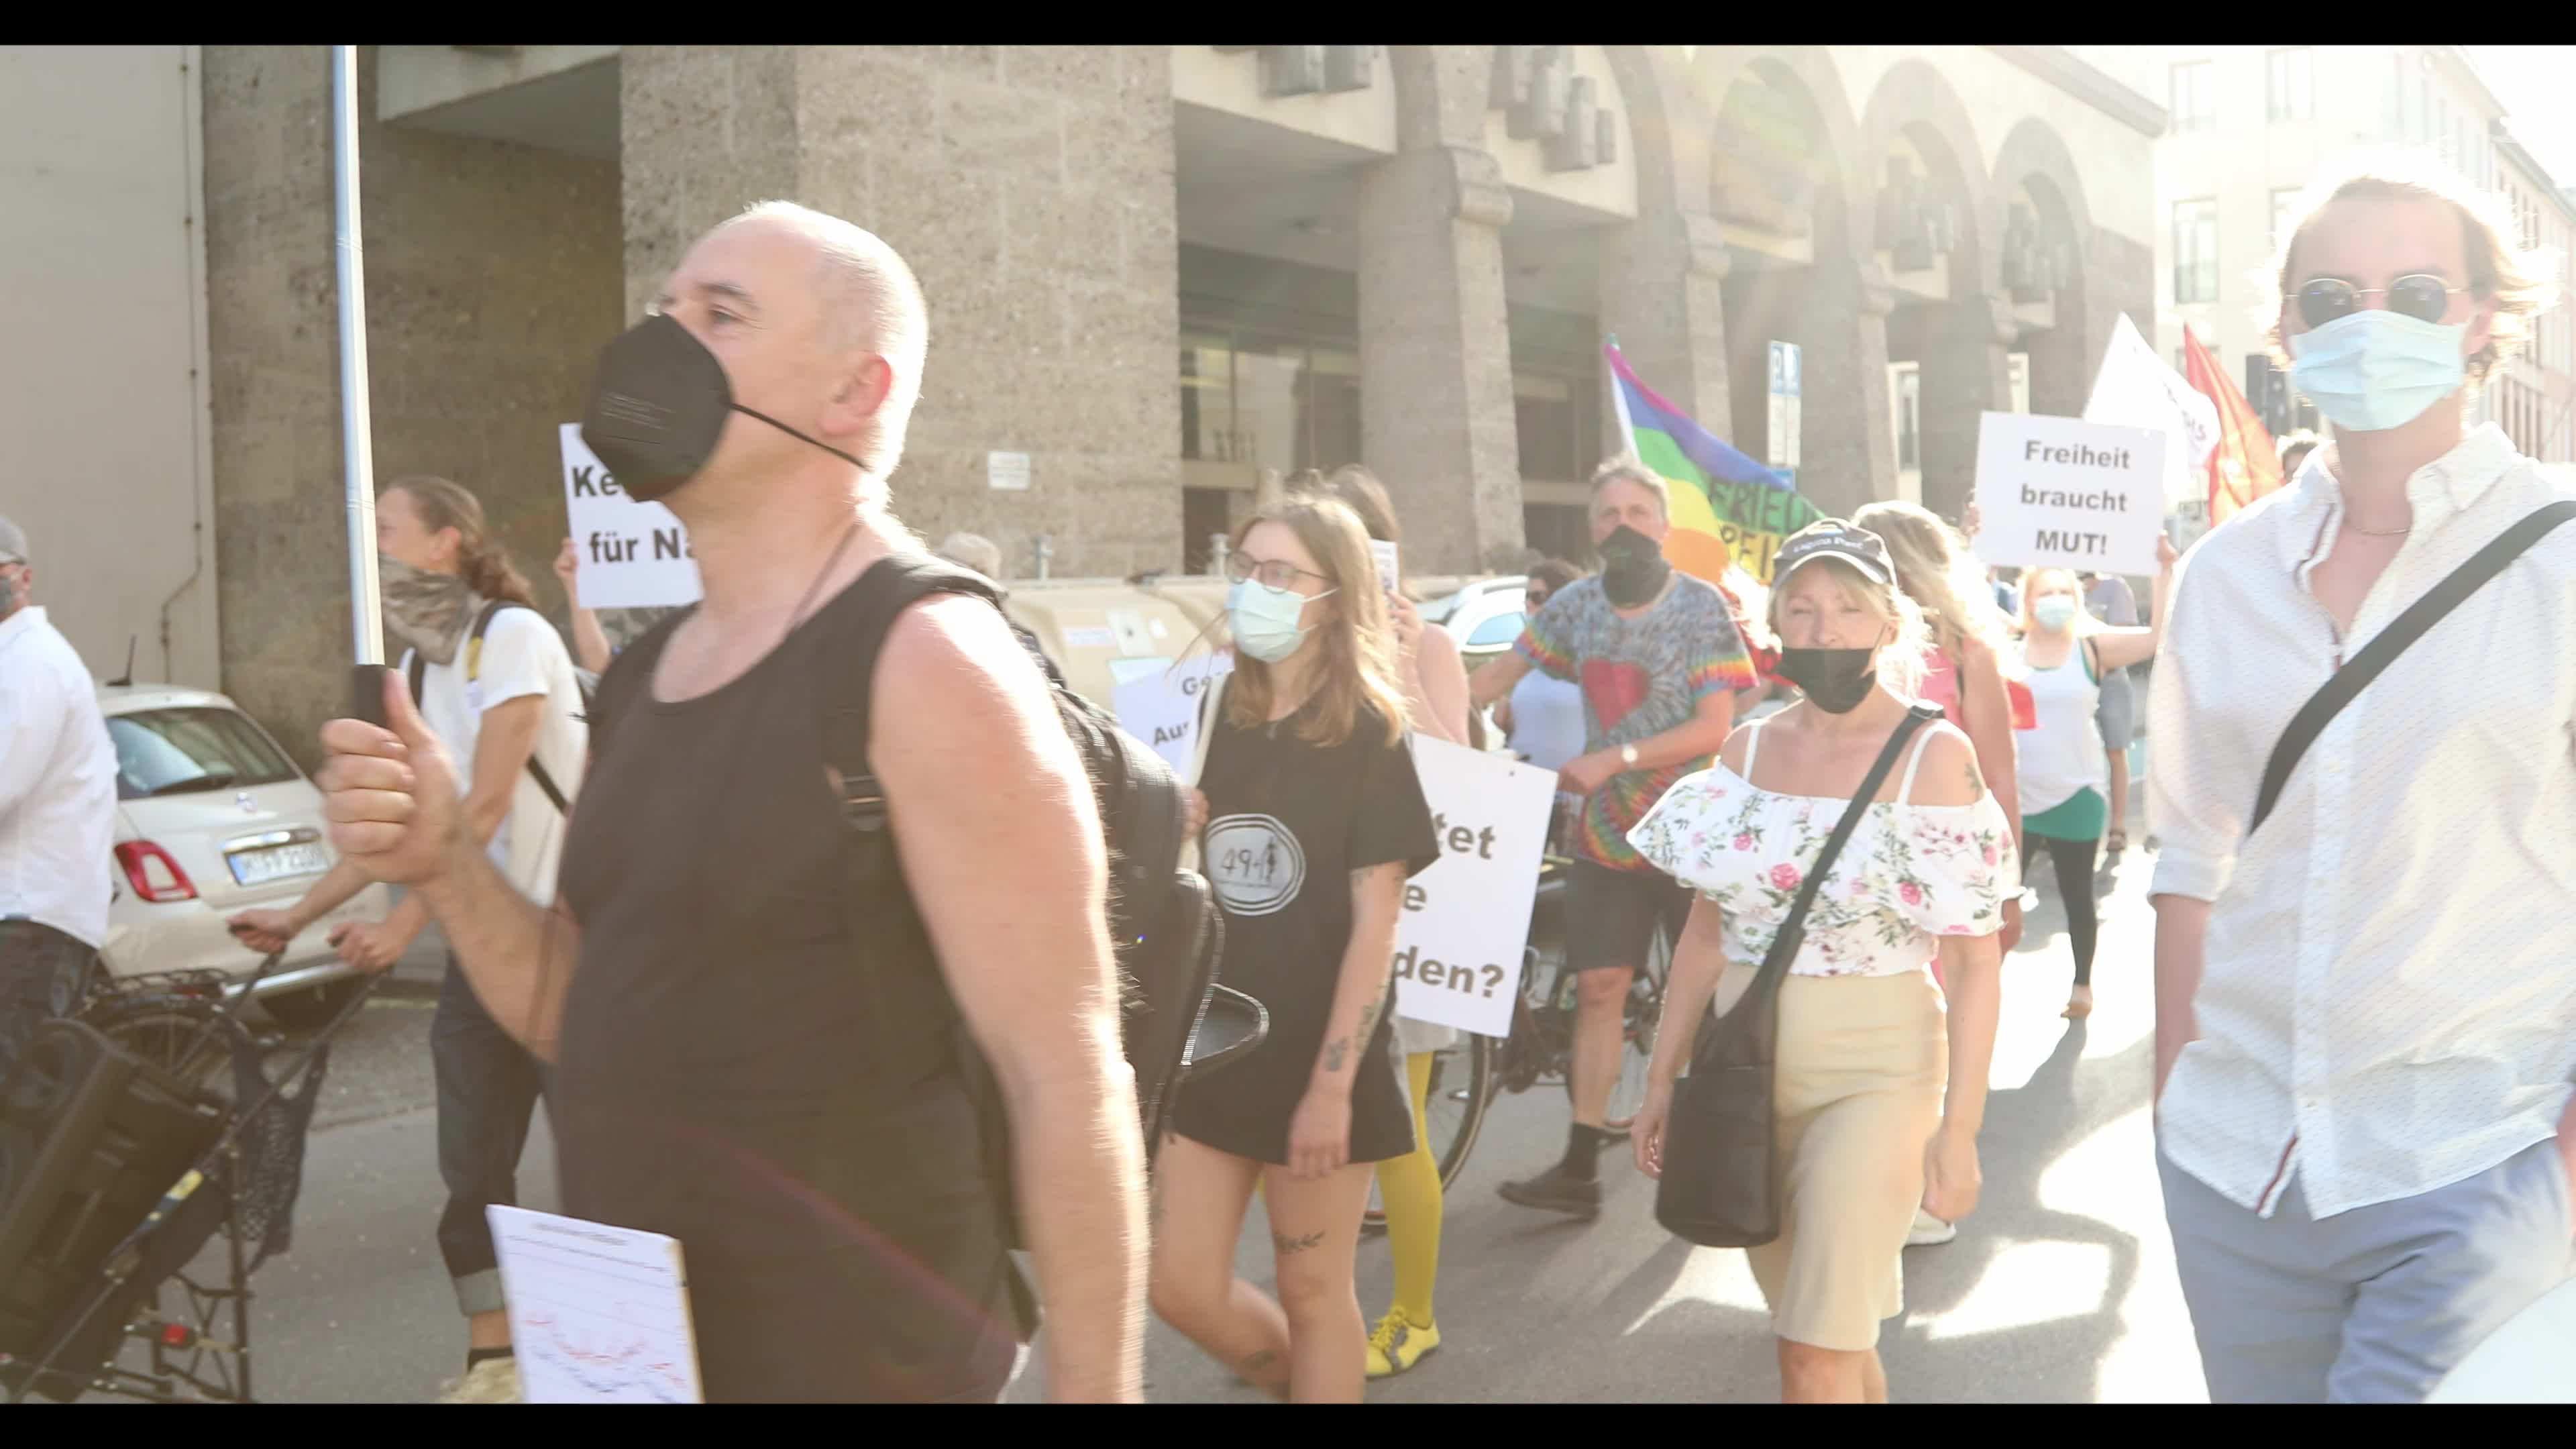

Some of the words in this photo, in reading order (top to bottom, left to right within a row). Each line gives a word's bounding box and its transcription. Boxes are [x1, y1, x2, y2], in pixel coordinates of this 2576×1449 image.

[2025, 440, 2131, 469] Freiheit
[2020, 484, 2127, 512] braucht
[588, 532, 639, 563] für
[2035, 529, 2108, 555] MUT!
